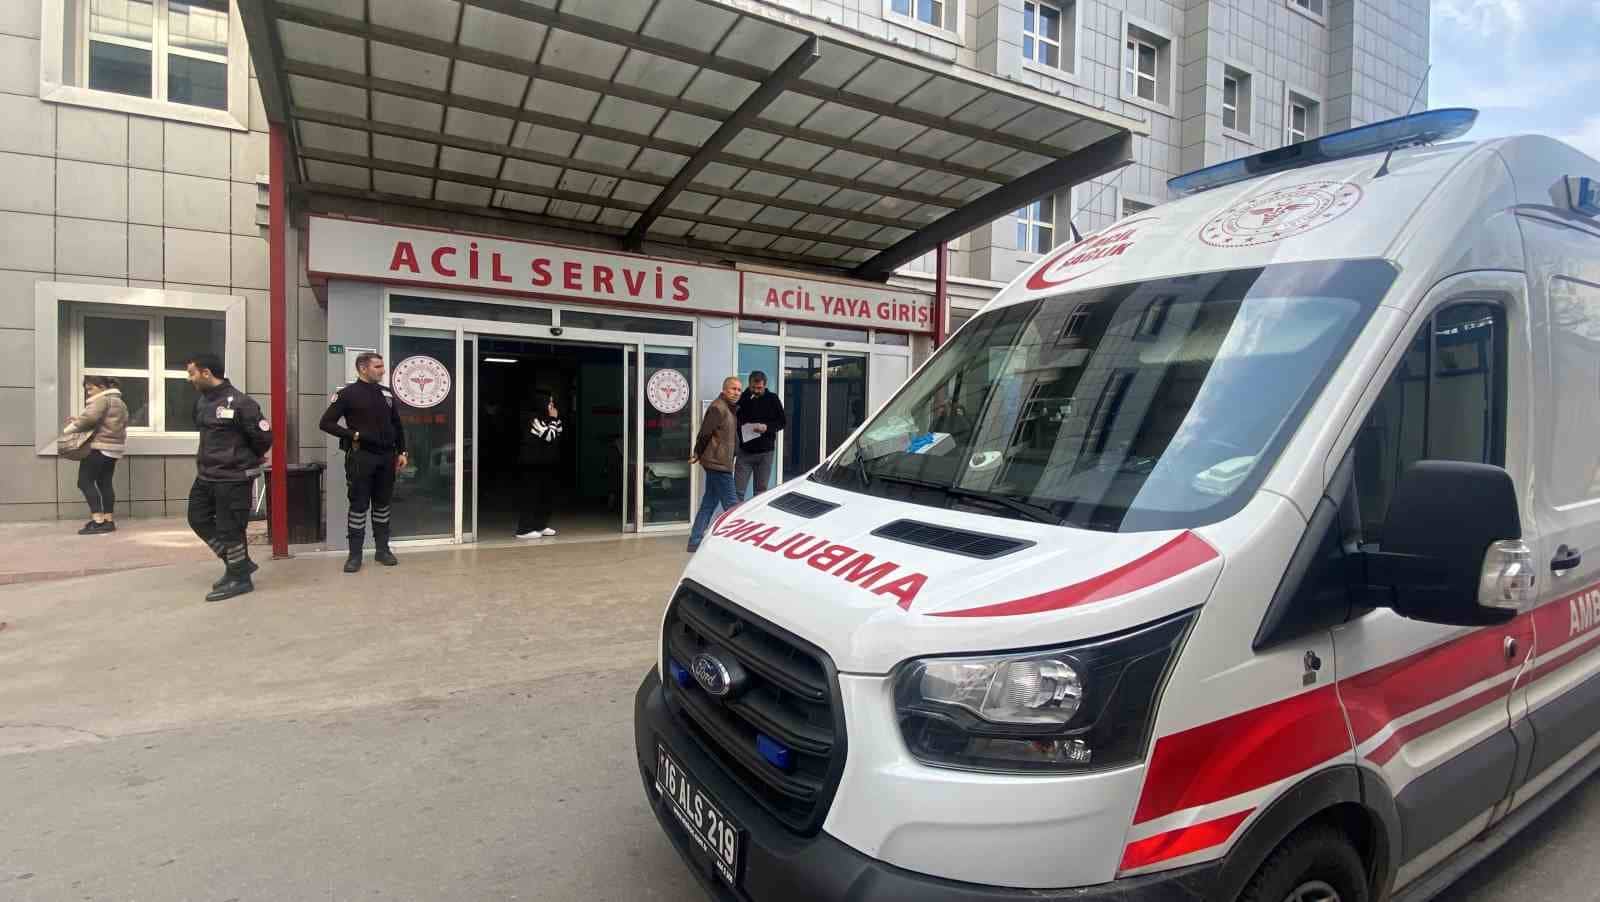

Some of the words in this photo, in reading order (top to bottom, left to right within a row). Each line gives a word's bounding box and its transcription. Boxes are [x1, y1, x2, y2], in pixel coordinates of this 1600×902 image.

[390, 241, 512, 283] ACİL
[531, 258, 690, 301] SERVİS
[764, 285, 815, 312] ACİL
[820, 295, 871, 319] YAYA
[877, 298, 934, 328] GİRİŞİ
[664, 757, 676, 795] 16
[679, 777, 703, 828] ALS
[707, 810, 734, 865] 219
